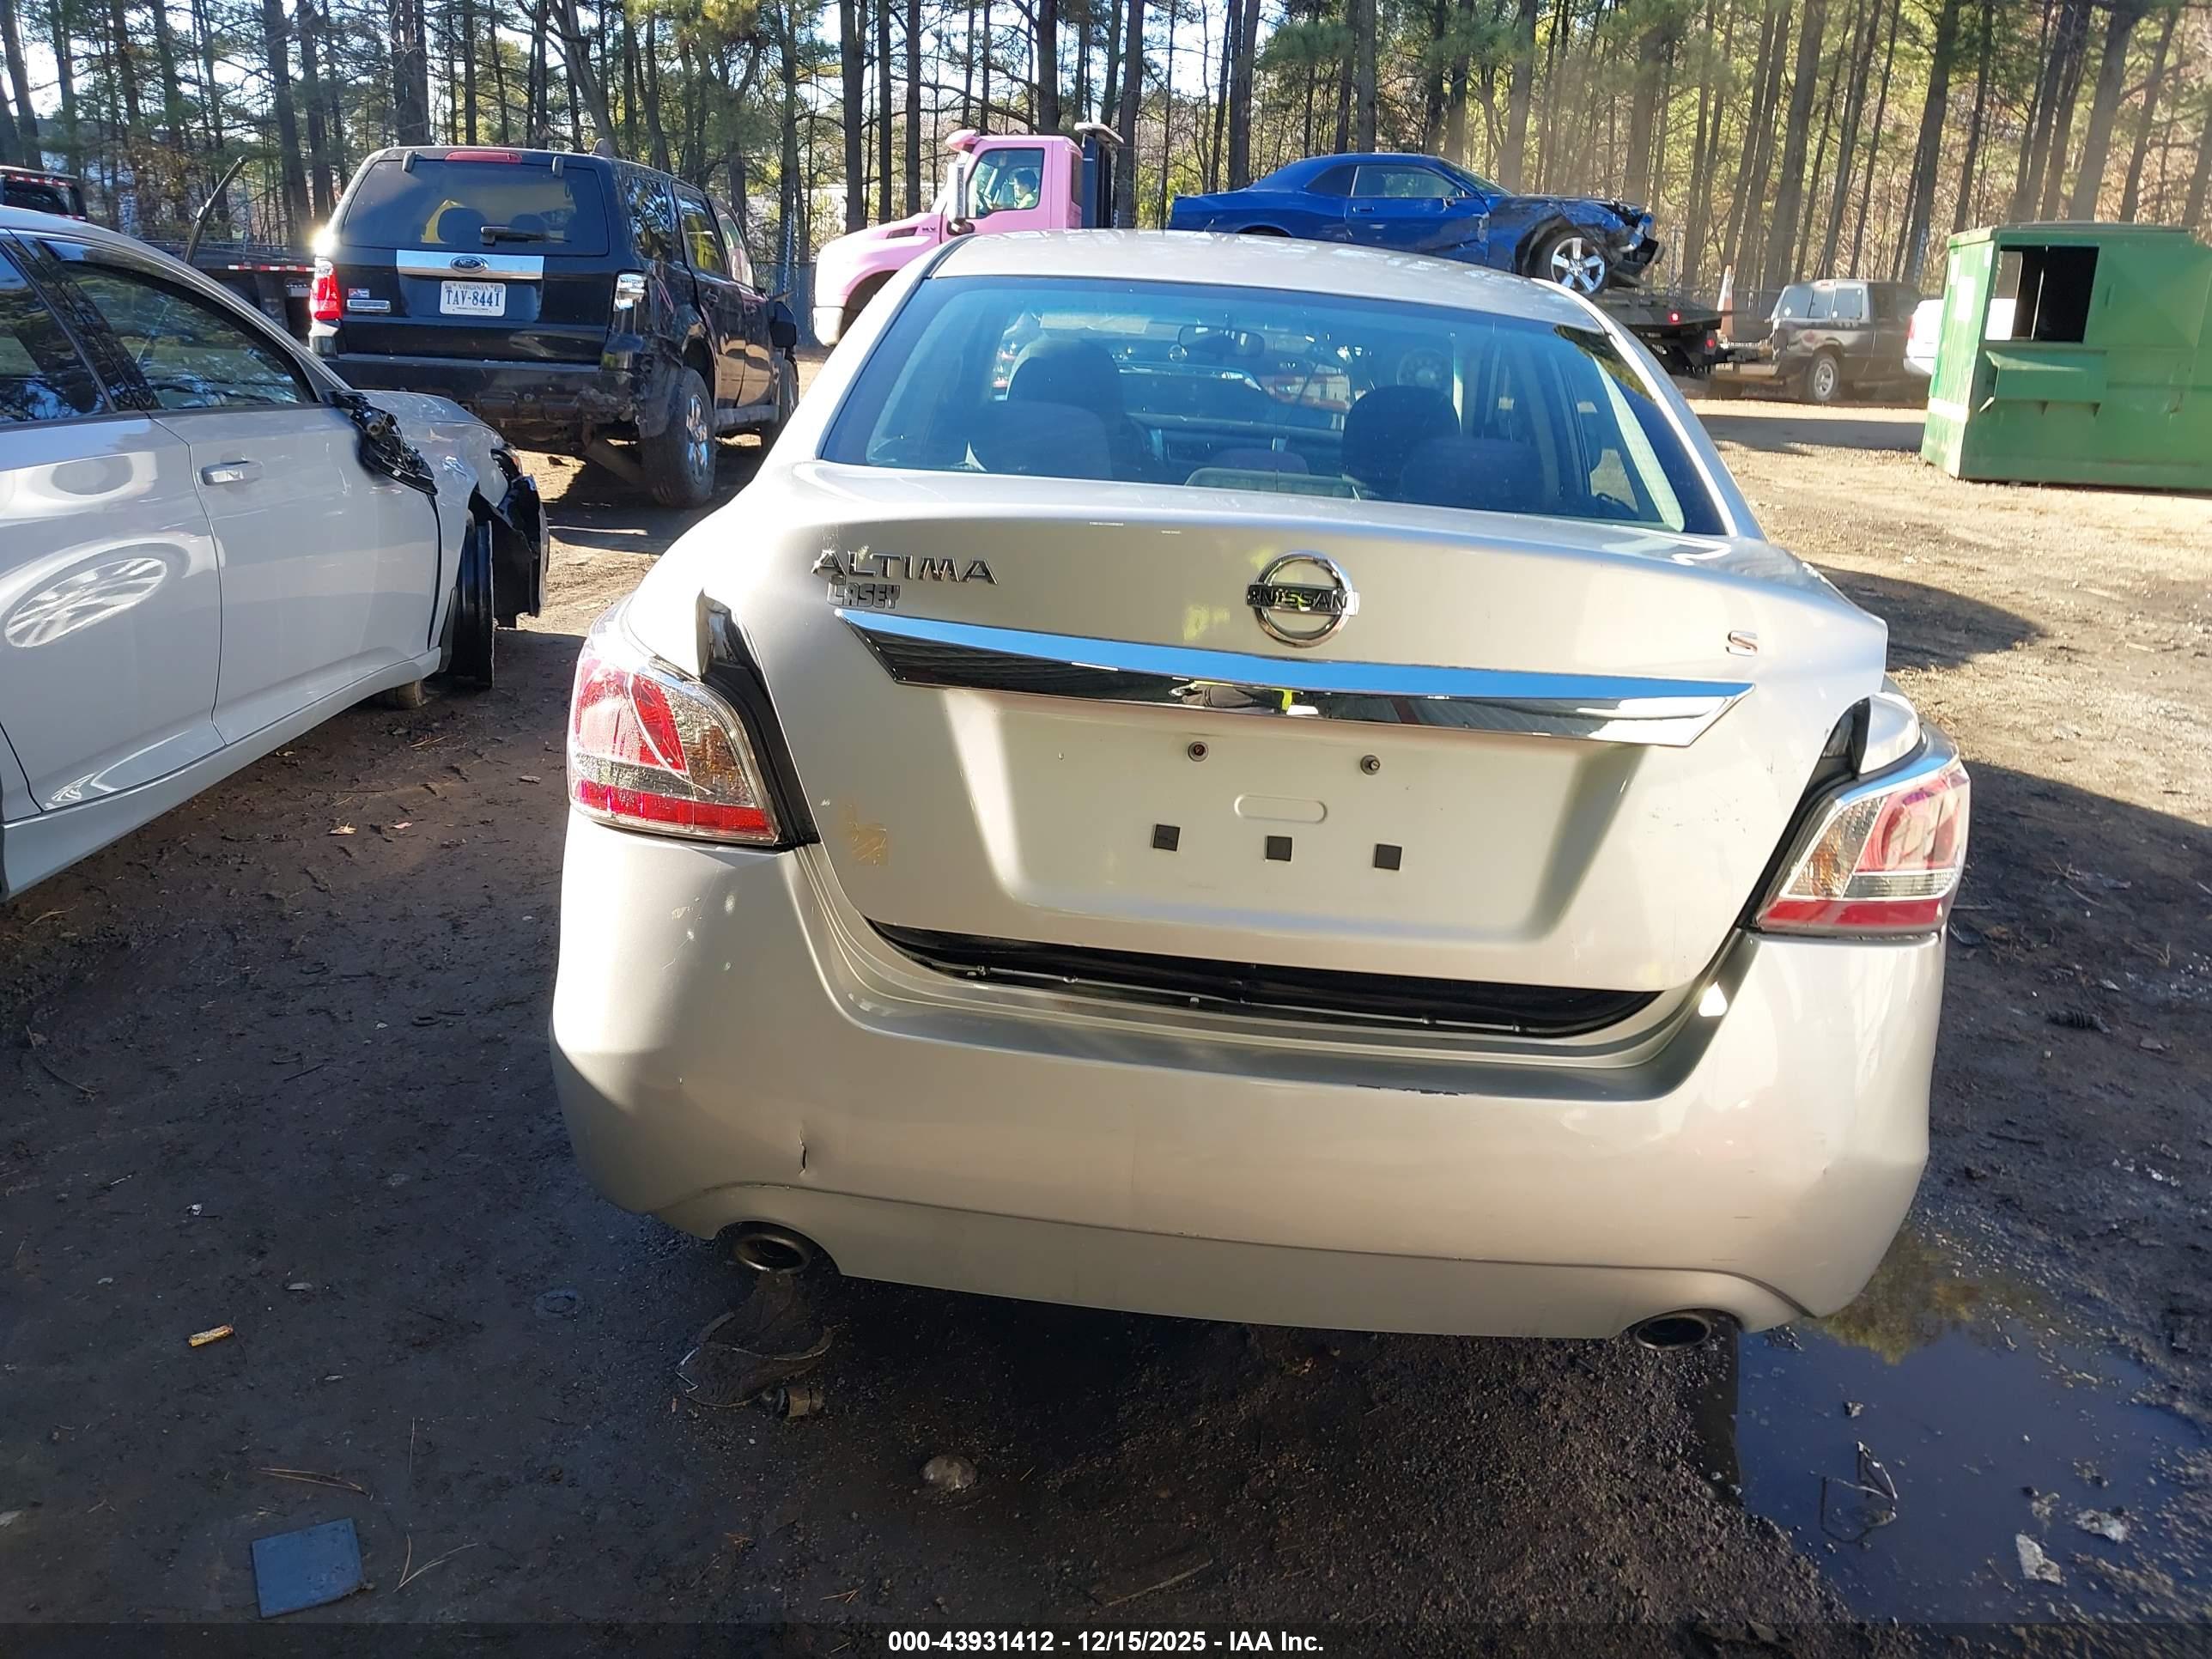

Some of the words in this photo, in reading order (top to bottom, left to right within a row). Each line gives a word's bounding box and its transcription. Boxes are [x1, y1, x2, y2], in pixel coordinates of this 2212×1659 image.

[446, 289, 501, 307] TAV-8441
[811, 550, 998, 585] ALTIMA
[827, 574, 901, 609] CASEY
[1258, 586, 1348, 612] NISSAN
[1726, 630, 1758, 657] S
